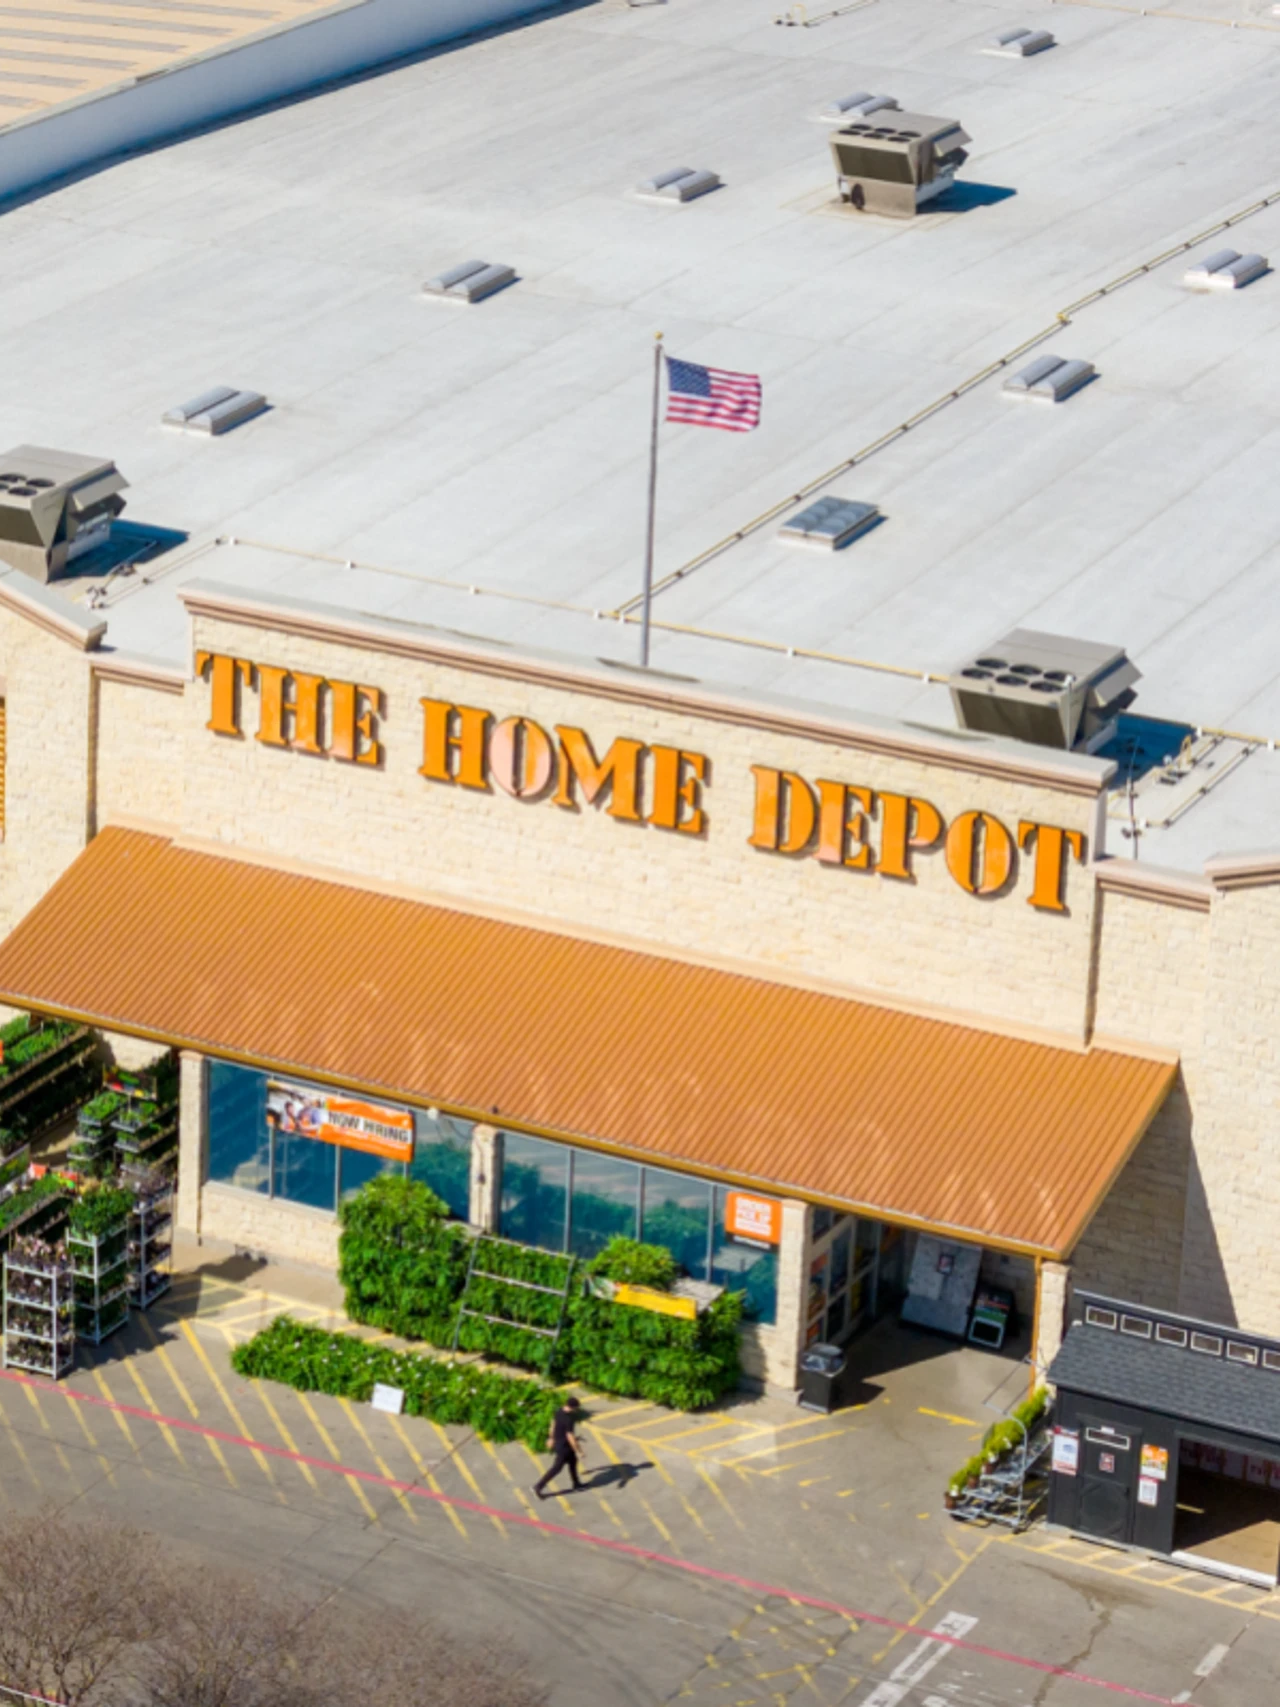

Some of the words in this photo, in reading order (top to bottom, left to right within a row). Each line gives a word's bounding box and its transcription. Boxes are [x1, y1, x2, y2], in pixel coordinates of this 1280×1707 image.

[195, 650, 383, 767] THE
[418, 696, 708, 834] HOME
[747, 764, 1085, 911] DEPOT
[329, 1111, 360, 1130] NOW
[363, 1120, 409, 1142] HIRING
